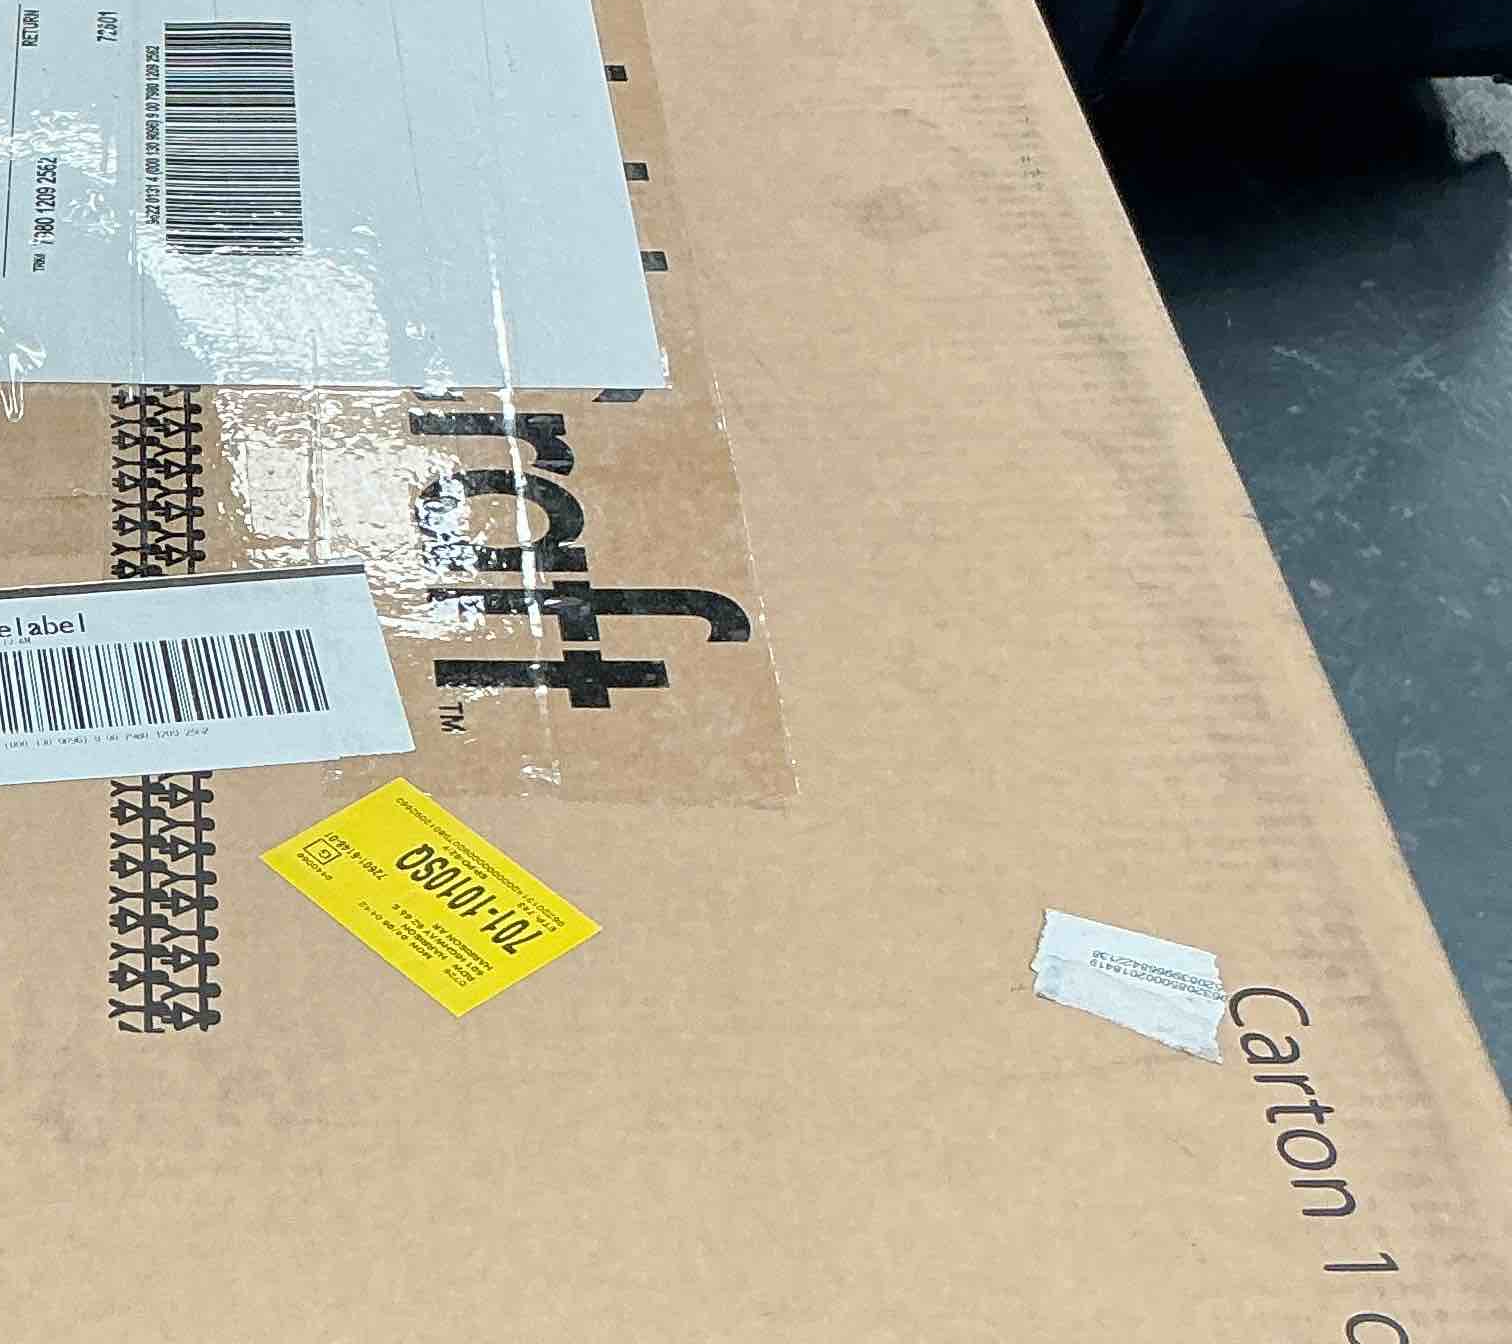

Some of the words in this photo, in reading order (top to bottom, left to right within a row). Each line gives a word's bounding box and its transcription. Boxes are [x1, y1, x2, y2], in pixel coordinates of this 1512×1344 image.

[21, 9, 40, 47] RETURN
[96, 11, 119, 42] 72601
[36, 157, 58, 185] 2562
[34, 186, 57, 214] 1209
[408, 387, 752, 709] raft
[1227, 985, 1360, 1219] Carton
[1323, 1251, 1400, 1273] 1
